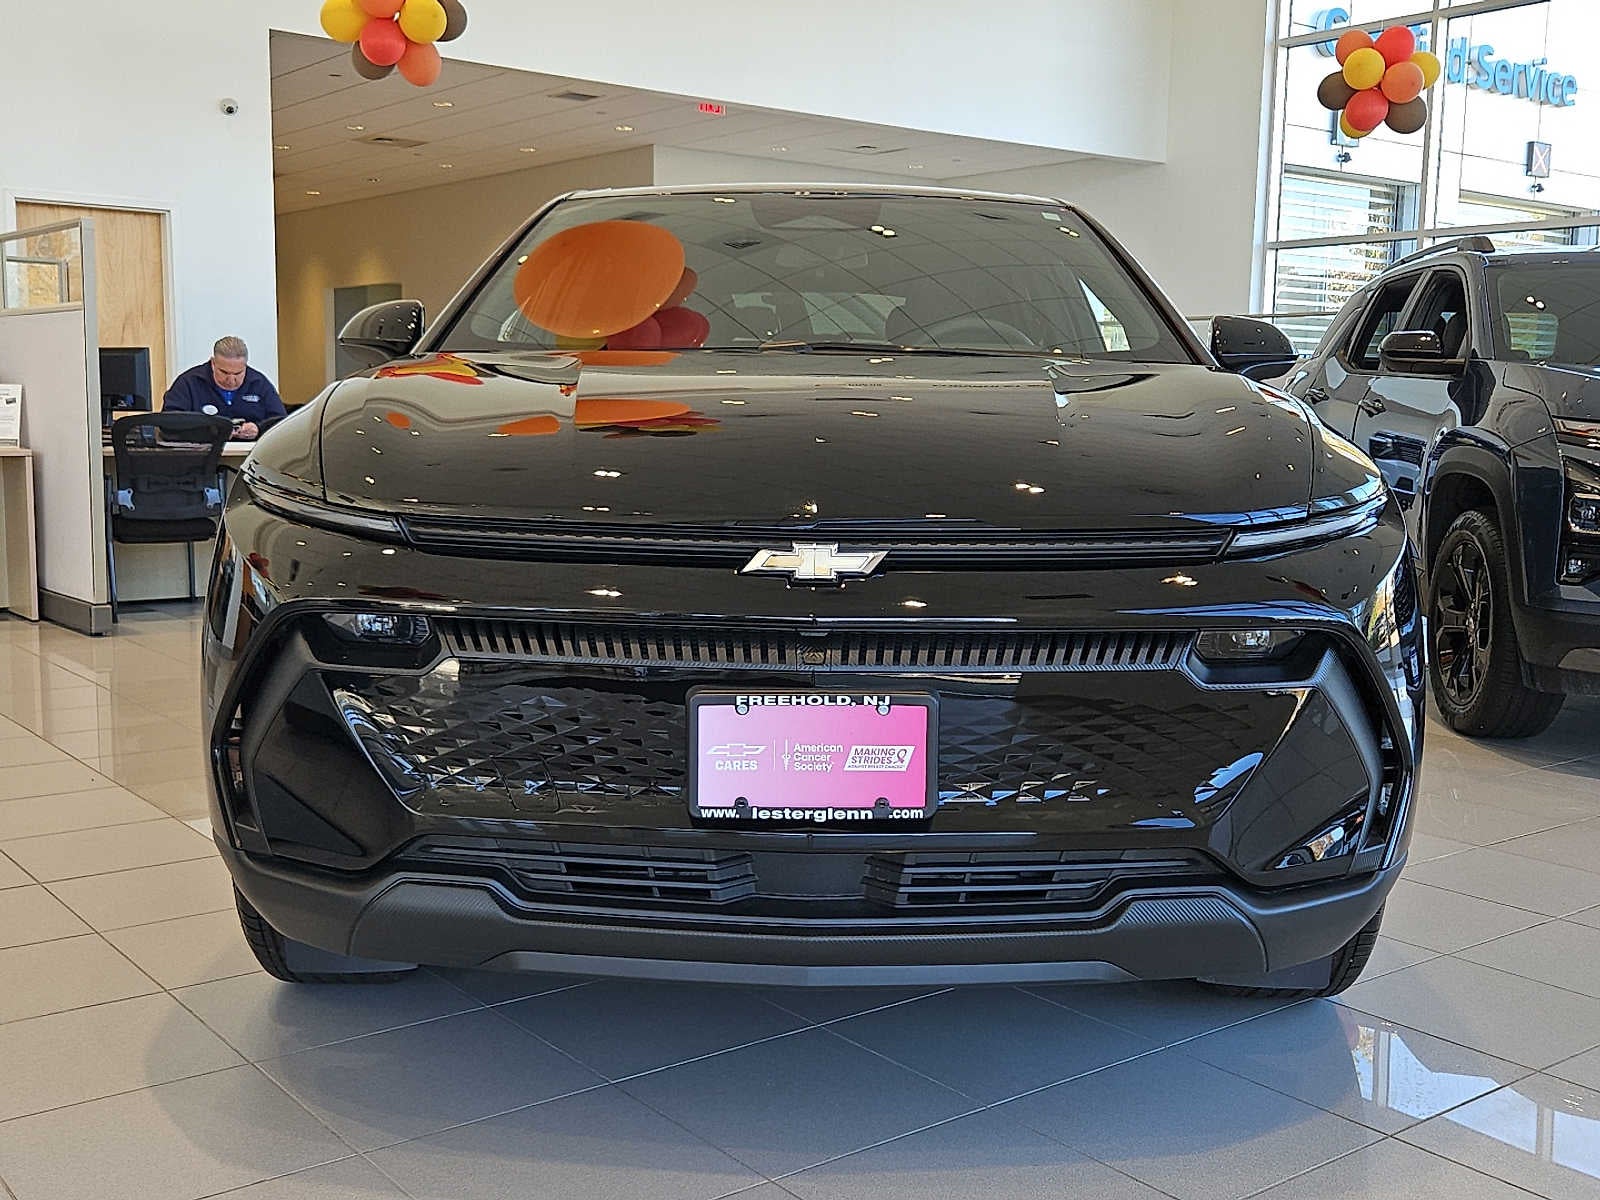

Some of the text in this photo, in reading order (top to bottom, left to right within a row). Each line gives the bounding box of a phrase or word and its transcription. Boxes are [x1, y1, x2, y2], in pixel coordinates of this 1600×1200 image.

[1472, 44, 1578, 107] Service
[736, 695, 891, 707] FREEHOLD, NJ
[793, 743, 844, 753] American
[853, 747, 896, 756] MAKING
[793, 753, 832, 761] Cancer
[851, 756, 893, 764] STRIDES
[714, 760, 759, 771] CARES
[793, 761, 833, 773] Society
[700, 807, 924, 822] www. lesterglenn .com
